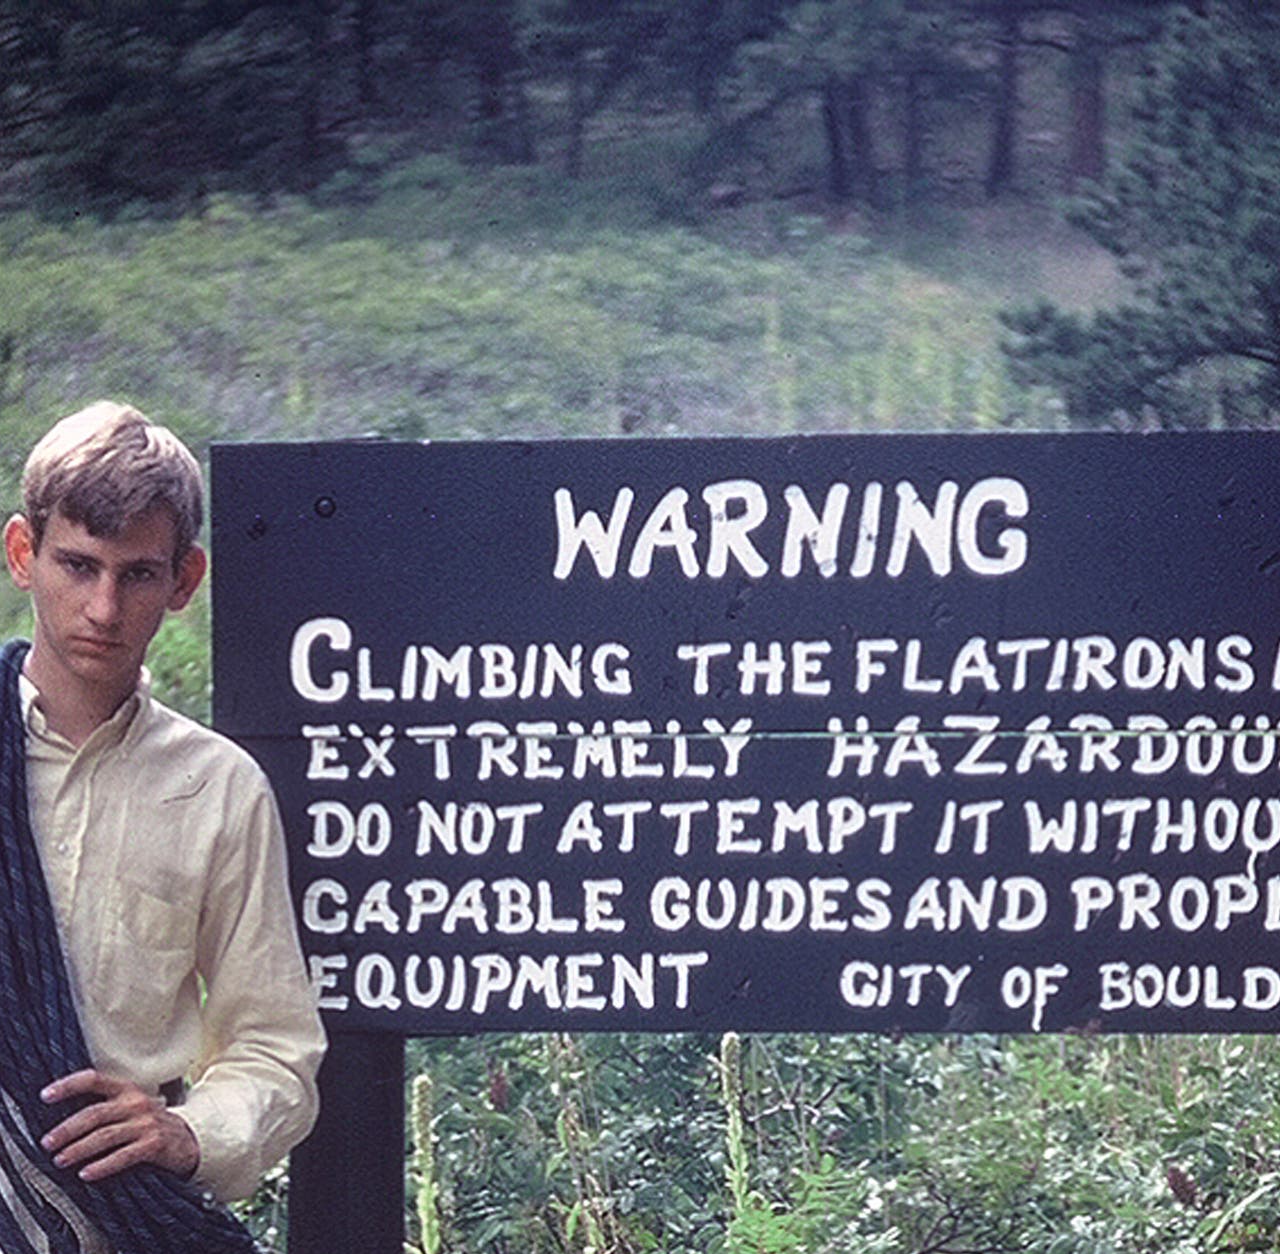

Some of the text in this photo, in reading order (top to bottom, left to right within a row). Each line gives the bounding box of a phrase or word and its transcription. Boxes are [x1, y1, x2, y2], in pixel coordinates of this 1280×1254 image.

[552, 477, 1030, 581] WARNING
[290, 617, 632, 703] CLIMBING
[676, 640, 833, 697] THE
[855, 635, 1255, 696] FLATIRONS
[302, 718, 753, 781] EXTREMELY
[306, 801, 392, 859] DO
[415, 800, 544, 857] NOT
[556, 797, 914, 857] ATTEMPT
[934, 799, 1004, 855] IT
[303, 878, 626, 935] CAPABLE
[649, 876, 893, 933] GUIDES
[903, 876, 1048, 932] AND
[308, 952, 709, 1015] EQUIPMENT
[839, 960, 972, 1008] CITY
[1000, 963, 1069, 1011] OF
